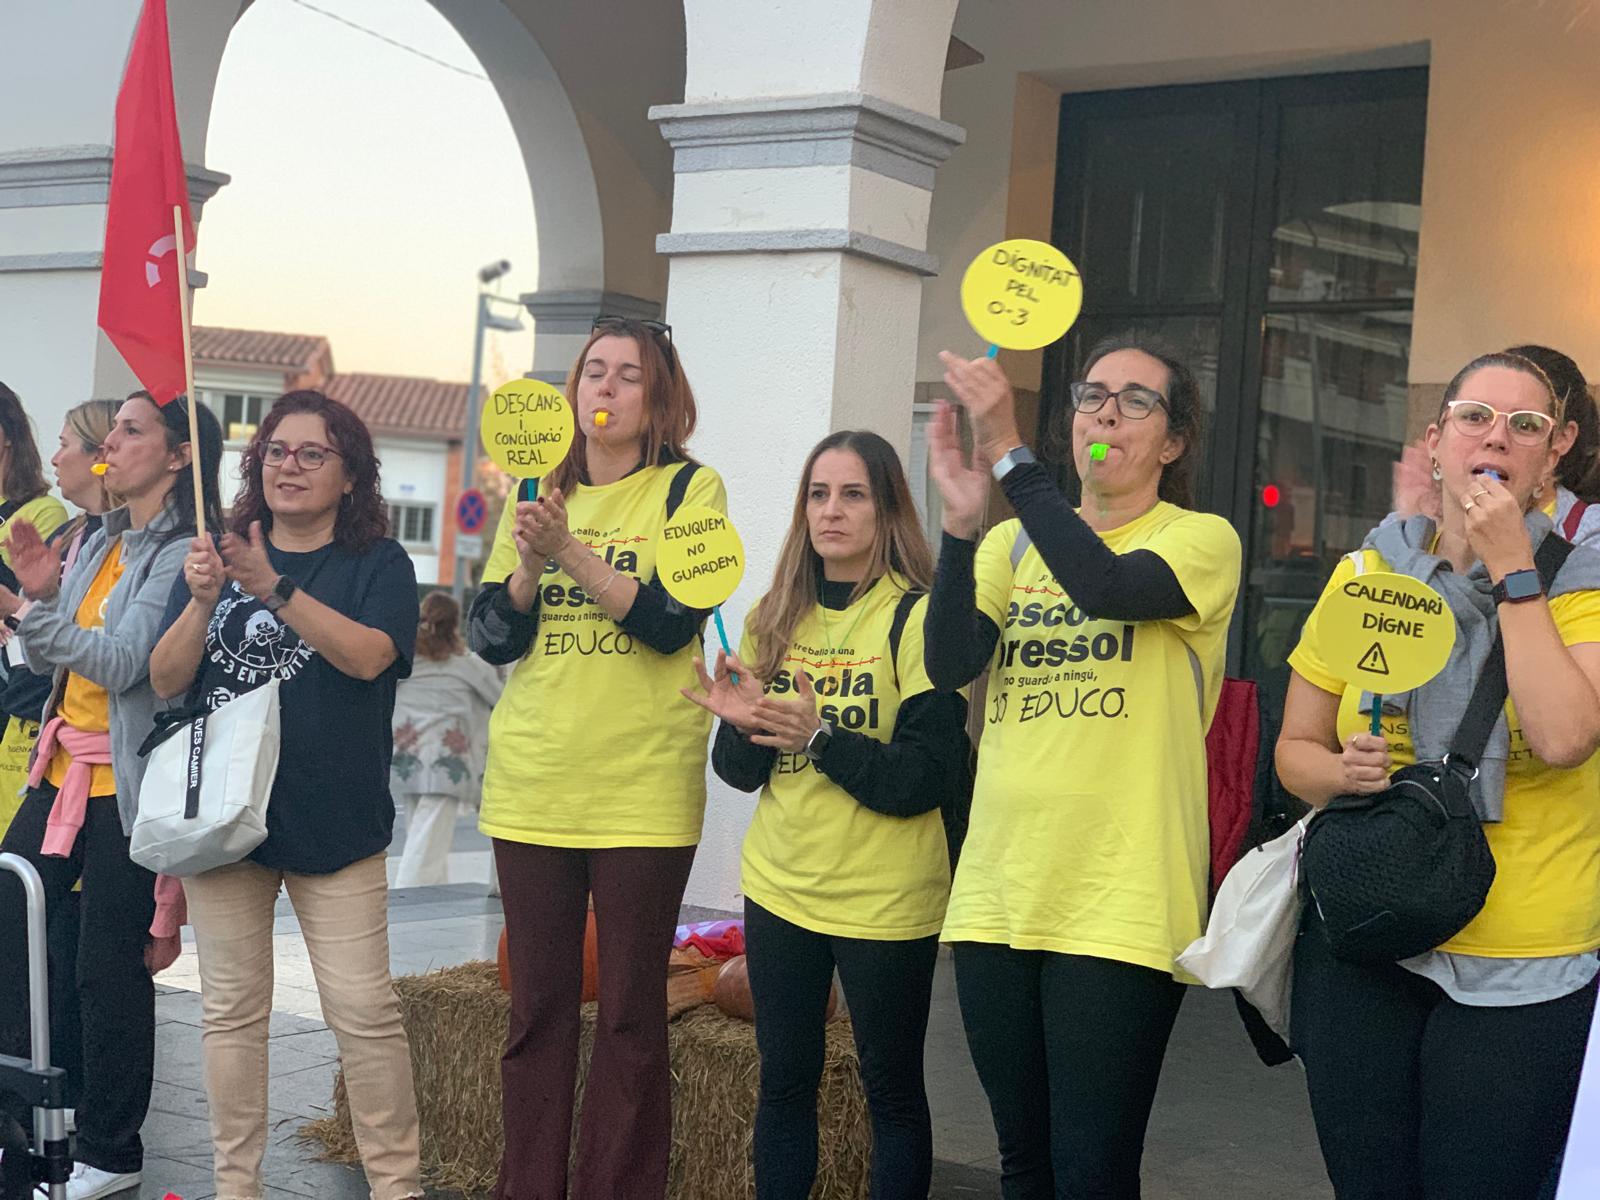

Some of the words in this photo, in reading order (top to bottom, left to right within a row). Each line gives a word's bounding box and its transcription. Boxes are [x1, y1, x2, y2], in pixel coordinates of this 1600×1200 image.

[1005, 278, 1040, 303] PEL
[494, 392, 563, 415] DESCANS
[519, 414, 524, 430] i
[506, 449, 549, 466] REAL
[663, 516, 726, 541] EDUQUEM
[686, 542, 706, 558] NO
[671, 554, 739, 584] GUARDEM
[542, 612, 576, 623] guardo
[544, 631, 637, 656] EDUCO.
[793, 642, 828, 656] treballo
[829, 647, 836, 655] a
[838, 648, 855, 656] una
[236, 666, 258, 685] EN
[1004, 675, 1015, 686] no
[1055, 672, 1060, 682] a
[1019, 687, 1129, 723] EDUCO.
[190, 746, 201, 789] CAMIER
